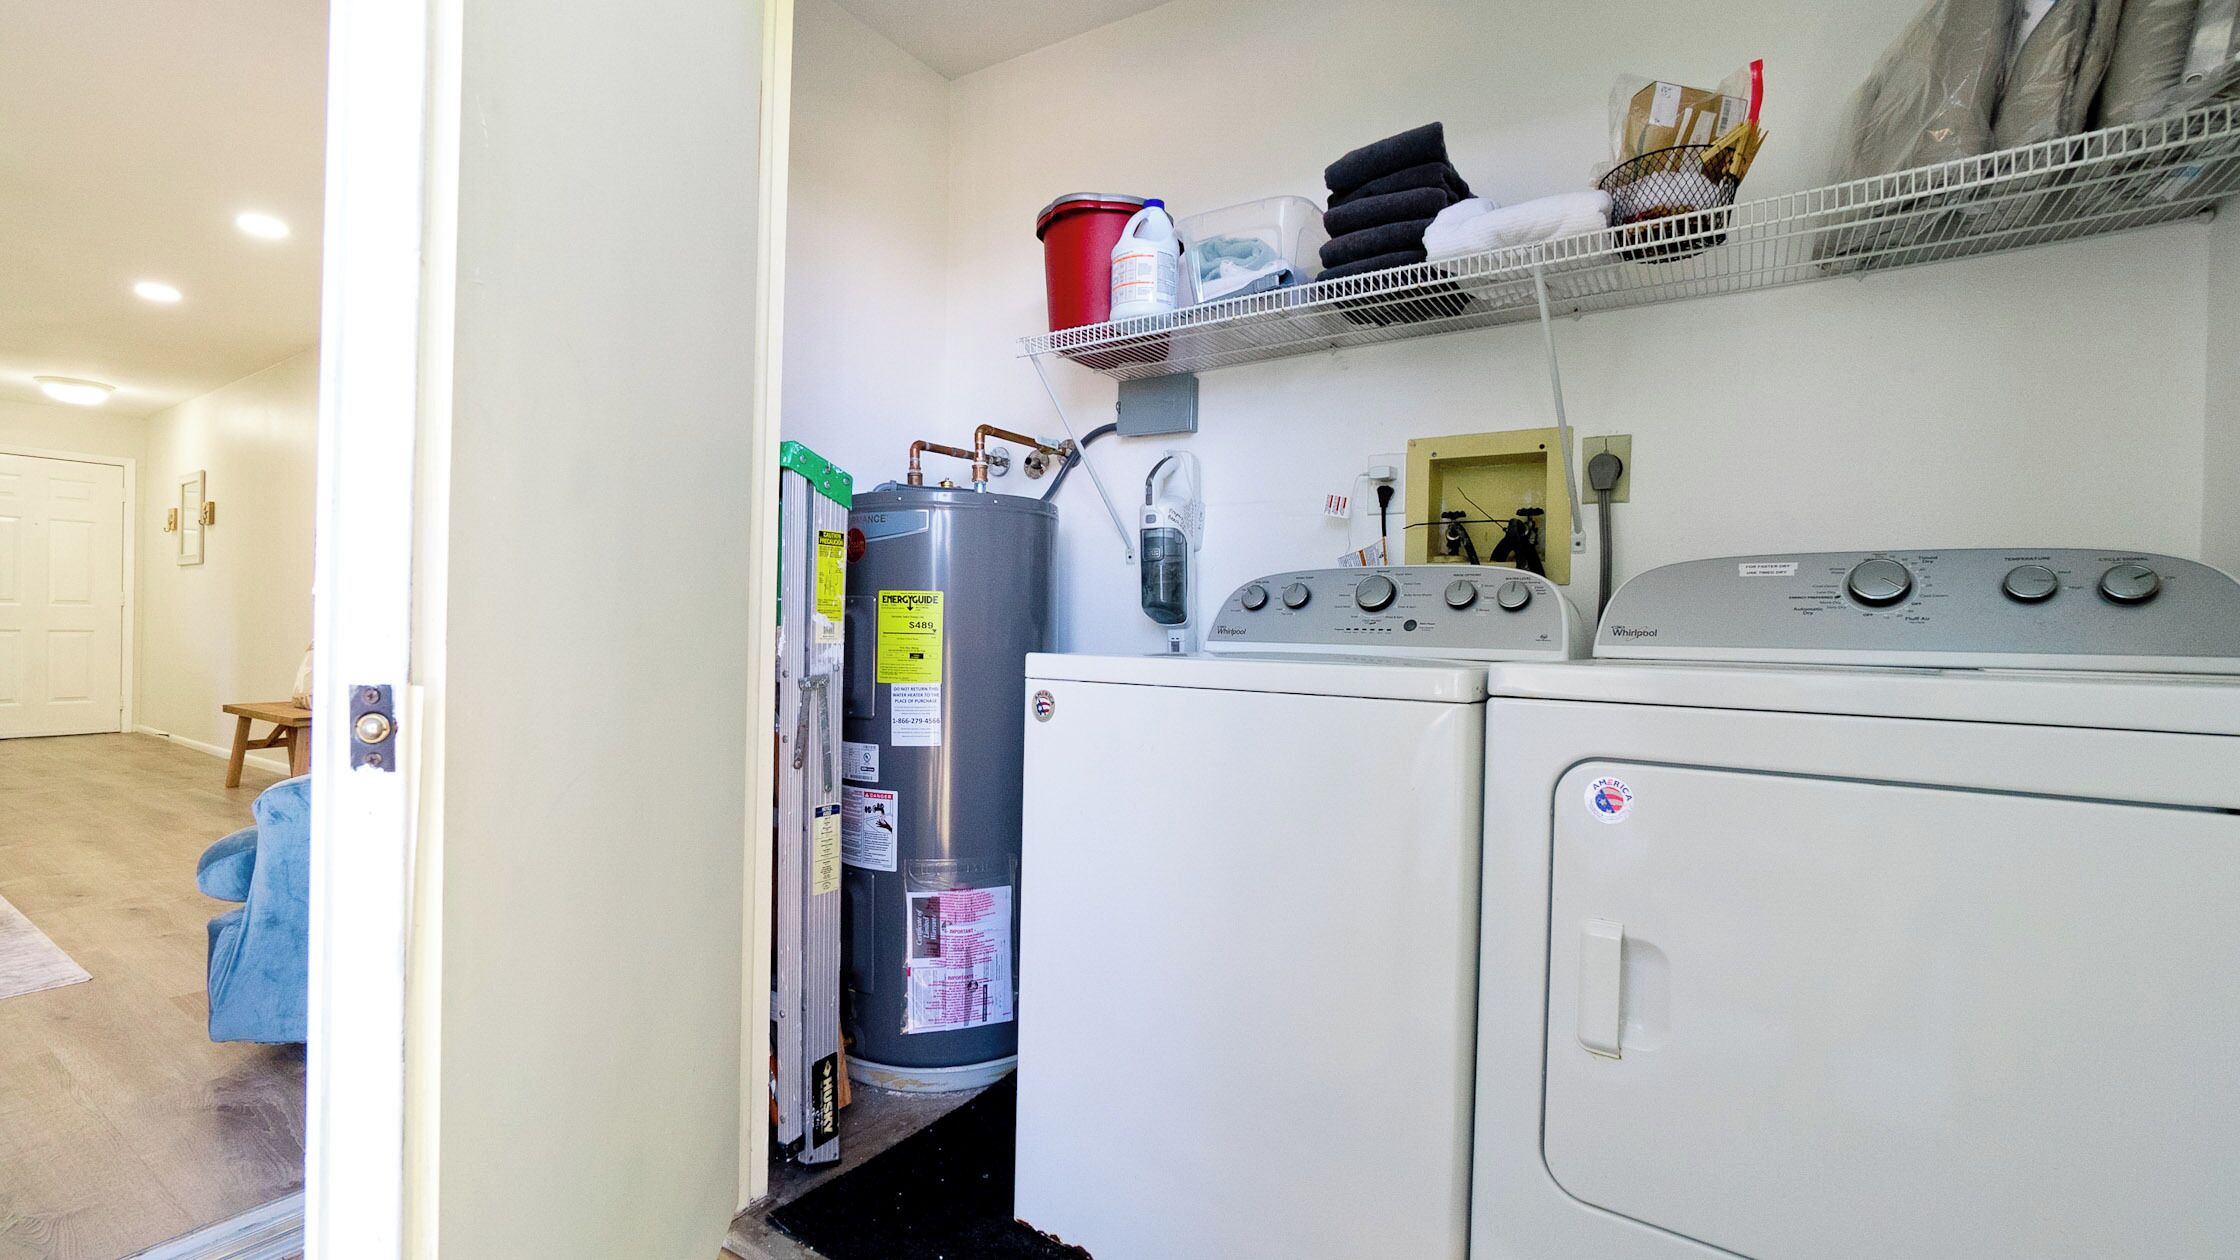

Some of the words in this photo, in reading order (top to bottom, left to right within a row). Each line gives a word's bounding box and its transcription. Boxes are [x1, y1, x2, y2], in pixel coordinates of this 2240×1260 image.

[1217, 627, 1246, 637] Whirlpool
[1612, 627, 1658, 640] Whirlpool
[1592, 778, 1633, 801] AMERICA
[822, 1077, 834, 1133] HUSKY
